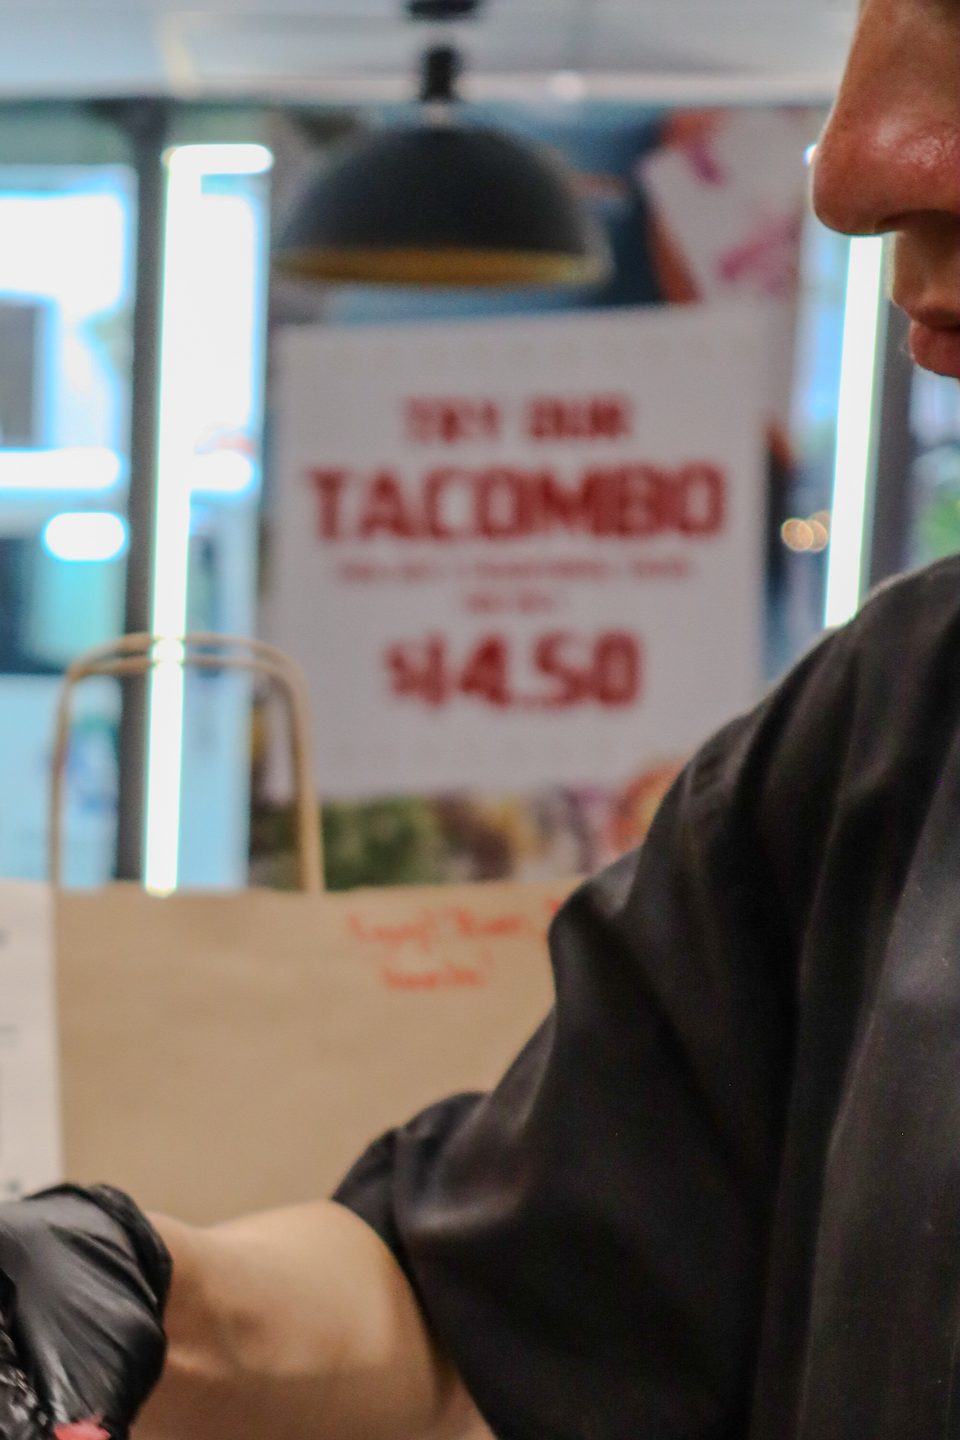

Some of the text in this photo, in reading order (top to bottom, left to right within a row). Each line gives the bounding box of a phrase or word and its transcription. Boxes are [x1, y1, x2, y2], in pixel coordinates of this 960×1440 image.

[405, 394, 630, 442] TRY OUR
[311, 463, 727, 541] TACOMBO
[385, 633, 642, 708] $14.50
